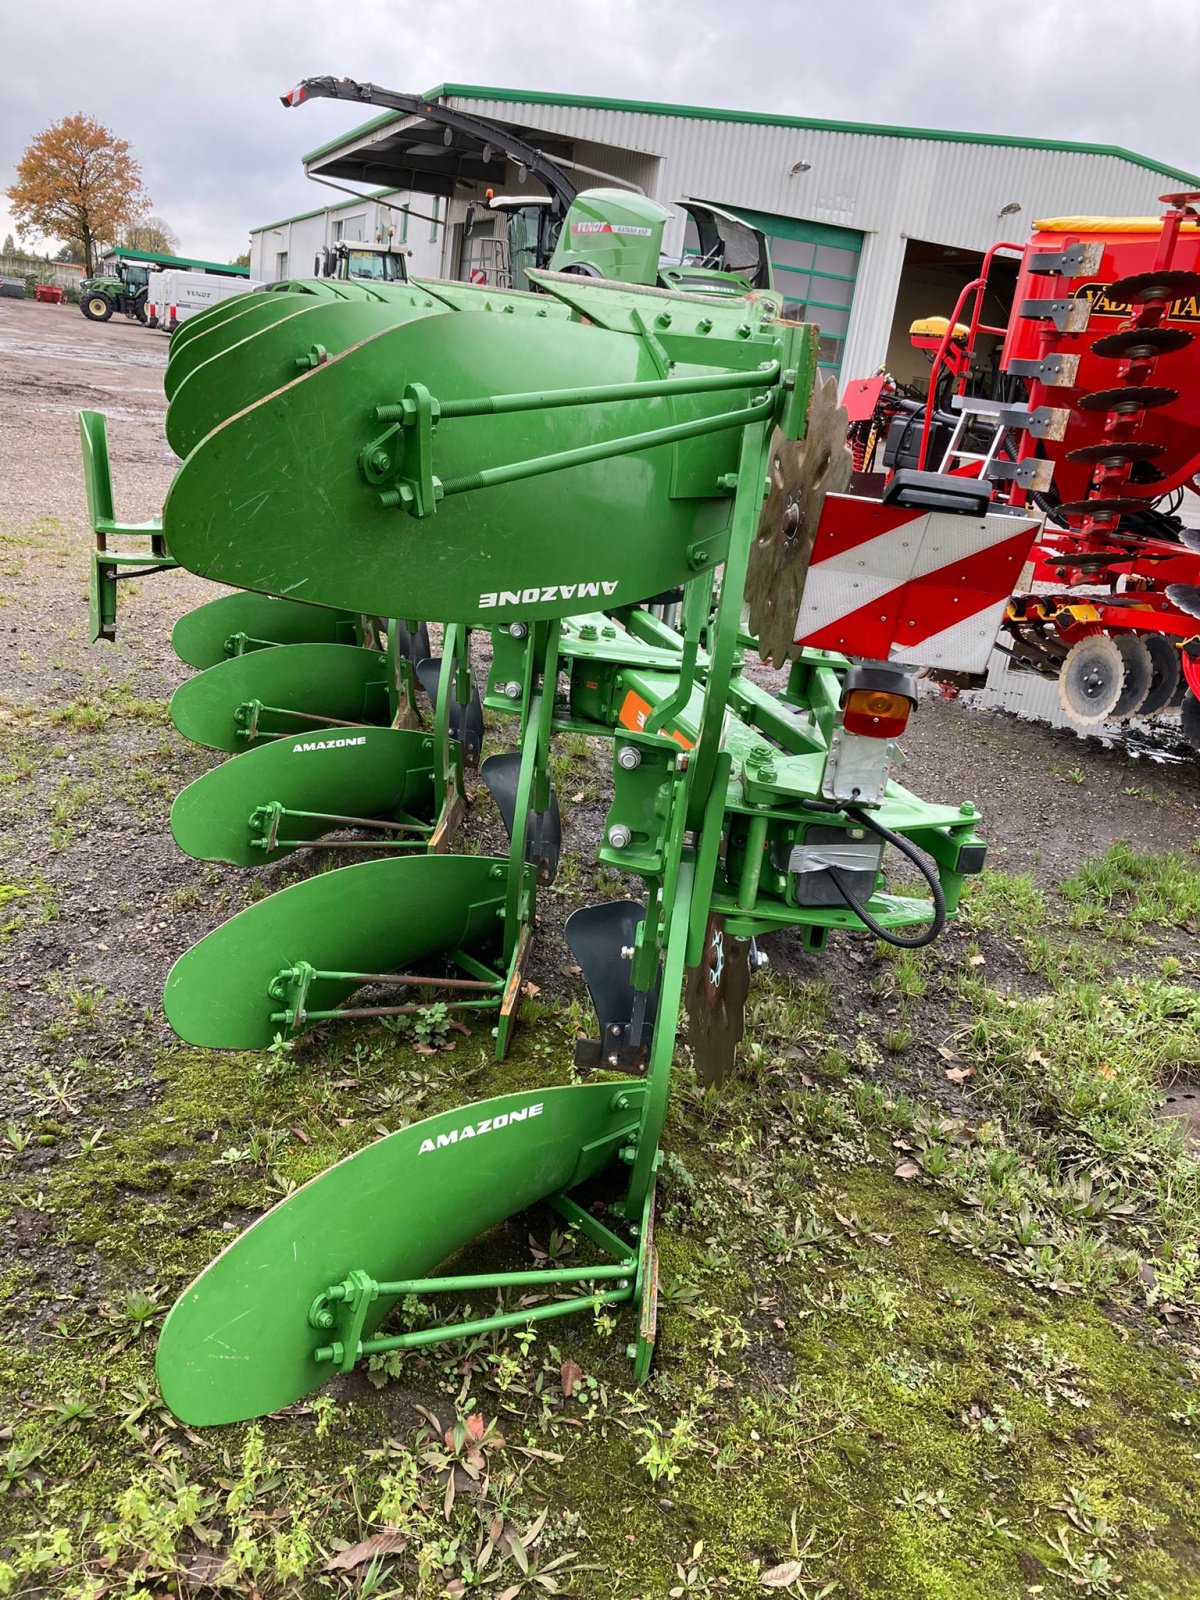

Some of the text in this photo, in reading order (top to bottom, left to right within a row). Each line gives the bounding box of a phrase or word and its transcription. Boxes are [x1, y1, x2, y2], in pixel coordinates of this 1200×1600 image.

[577, 222, 608, 233] FENDT
[478, 580, 619, 609] AMAZONE
[292, 736, 367, 753] AMAZONE
[417, 1102, 544, 1156] AMAZONE
